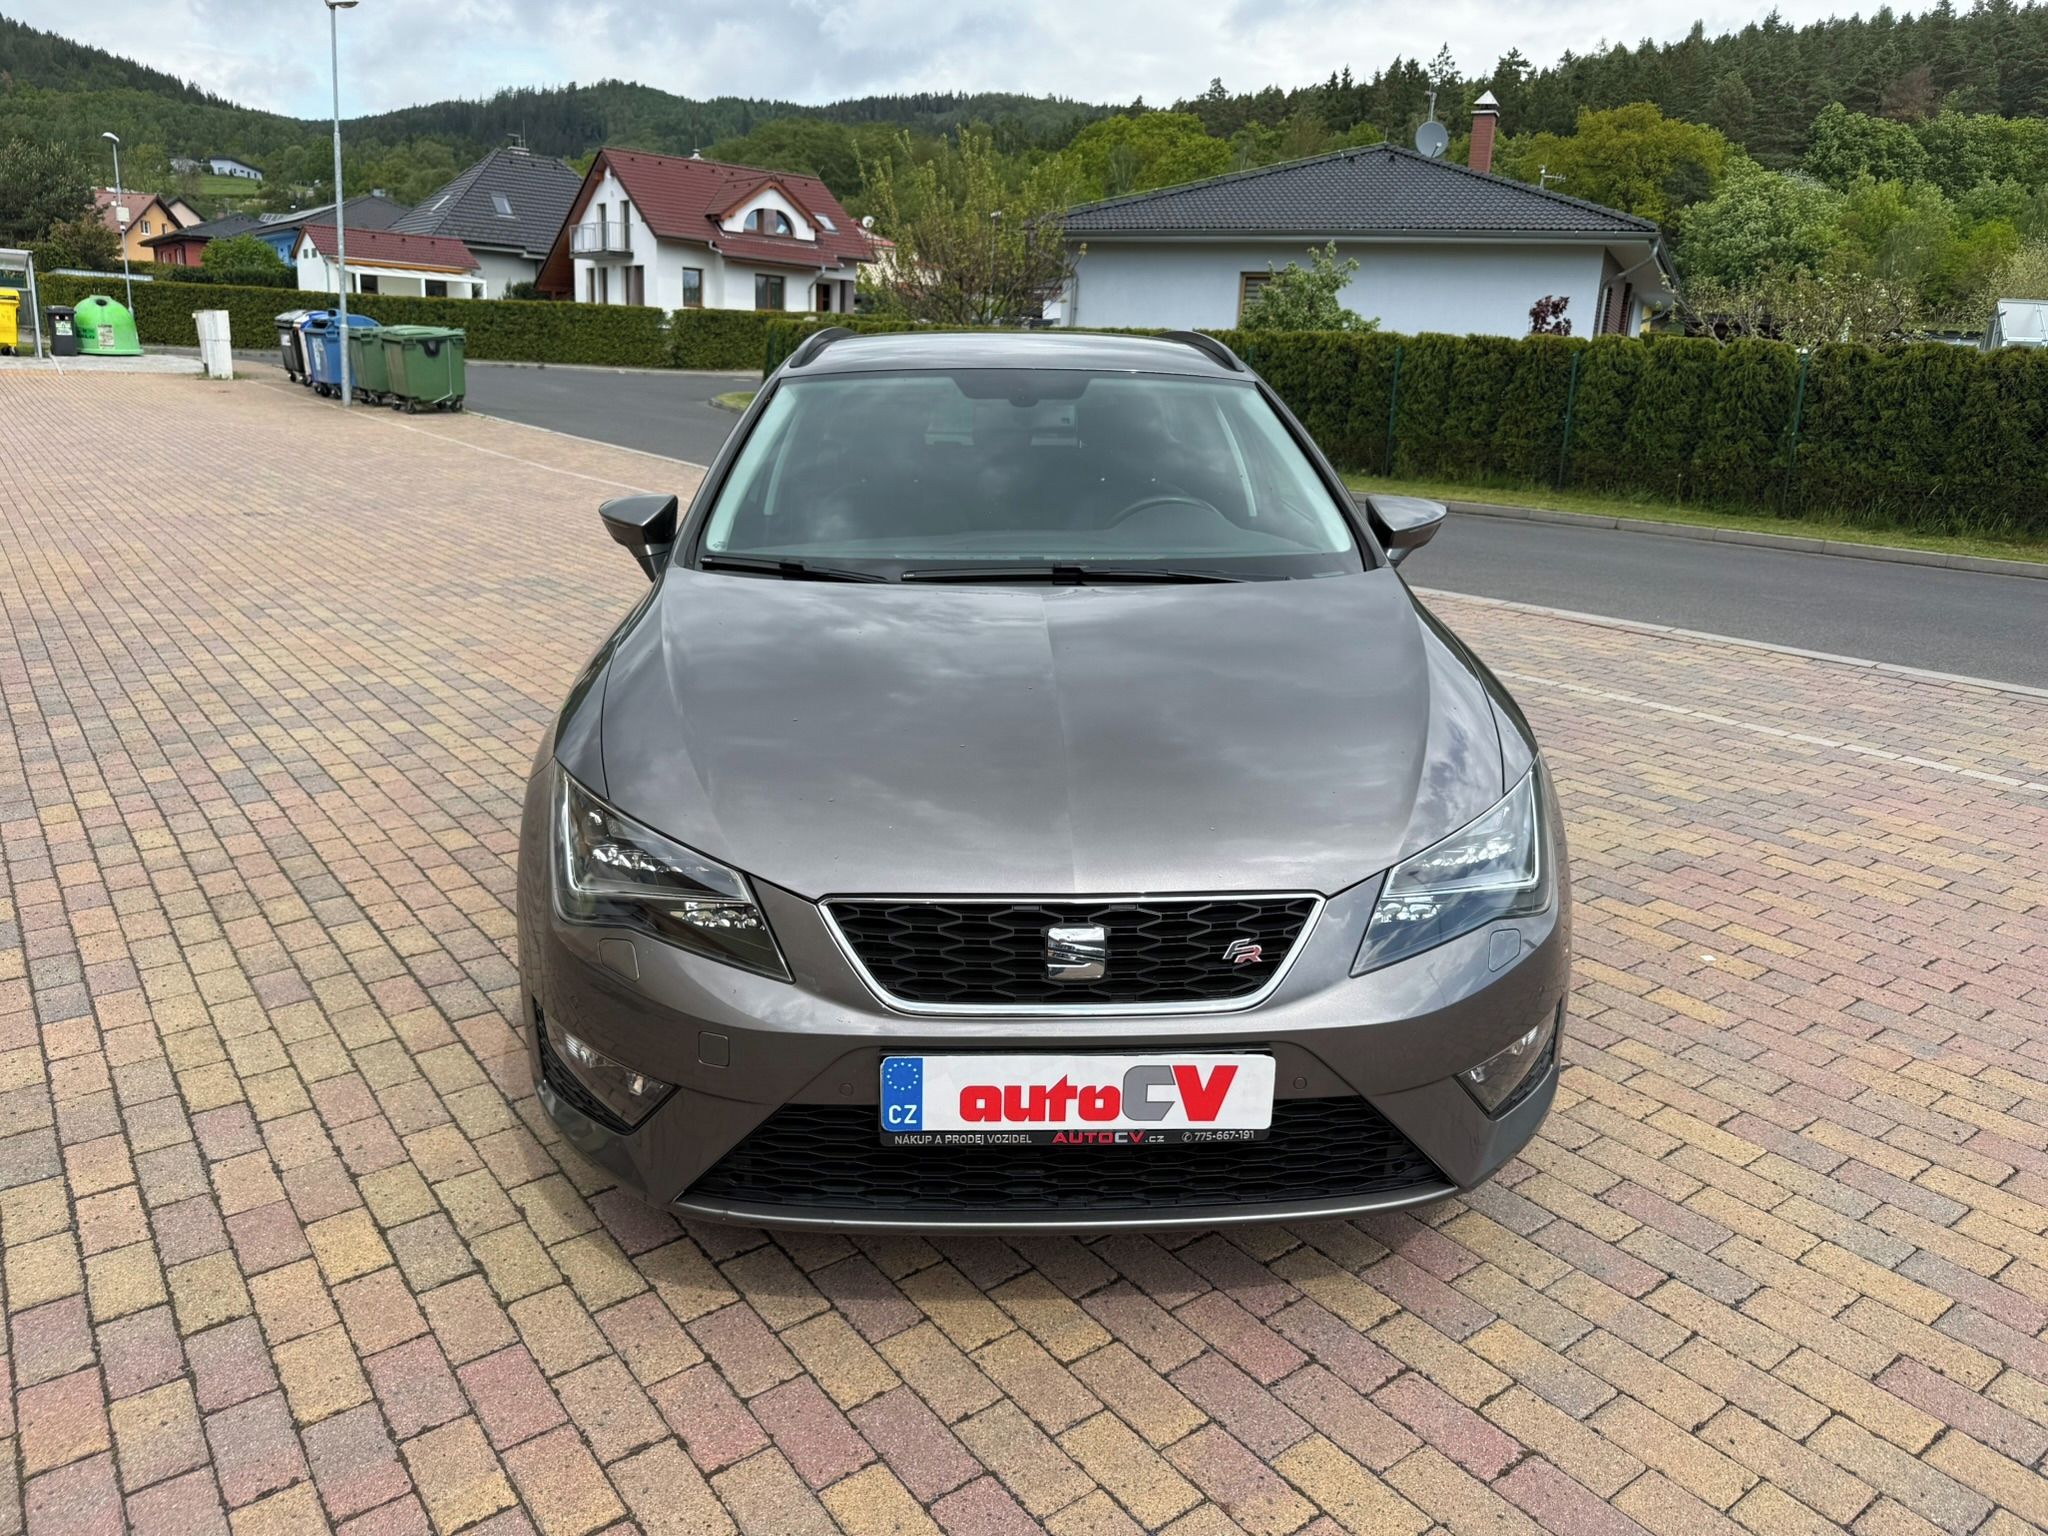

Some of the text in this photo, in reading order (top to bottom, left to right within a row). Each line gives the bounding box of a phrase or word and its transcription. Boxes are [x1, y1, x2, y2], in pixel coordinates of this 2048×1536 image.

[959, 1064, 1239, 1122] autoCV
[888, 1104, 917, 1125] CZ
[894, 1133, 1032, 1145] NÁKUP A PRODEJ VOZIDEL
[1194, 1130, 1255, 1142] 775-667-191
